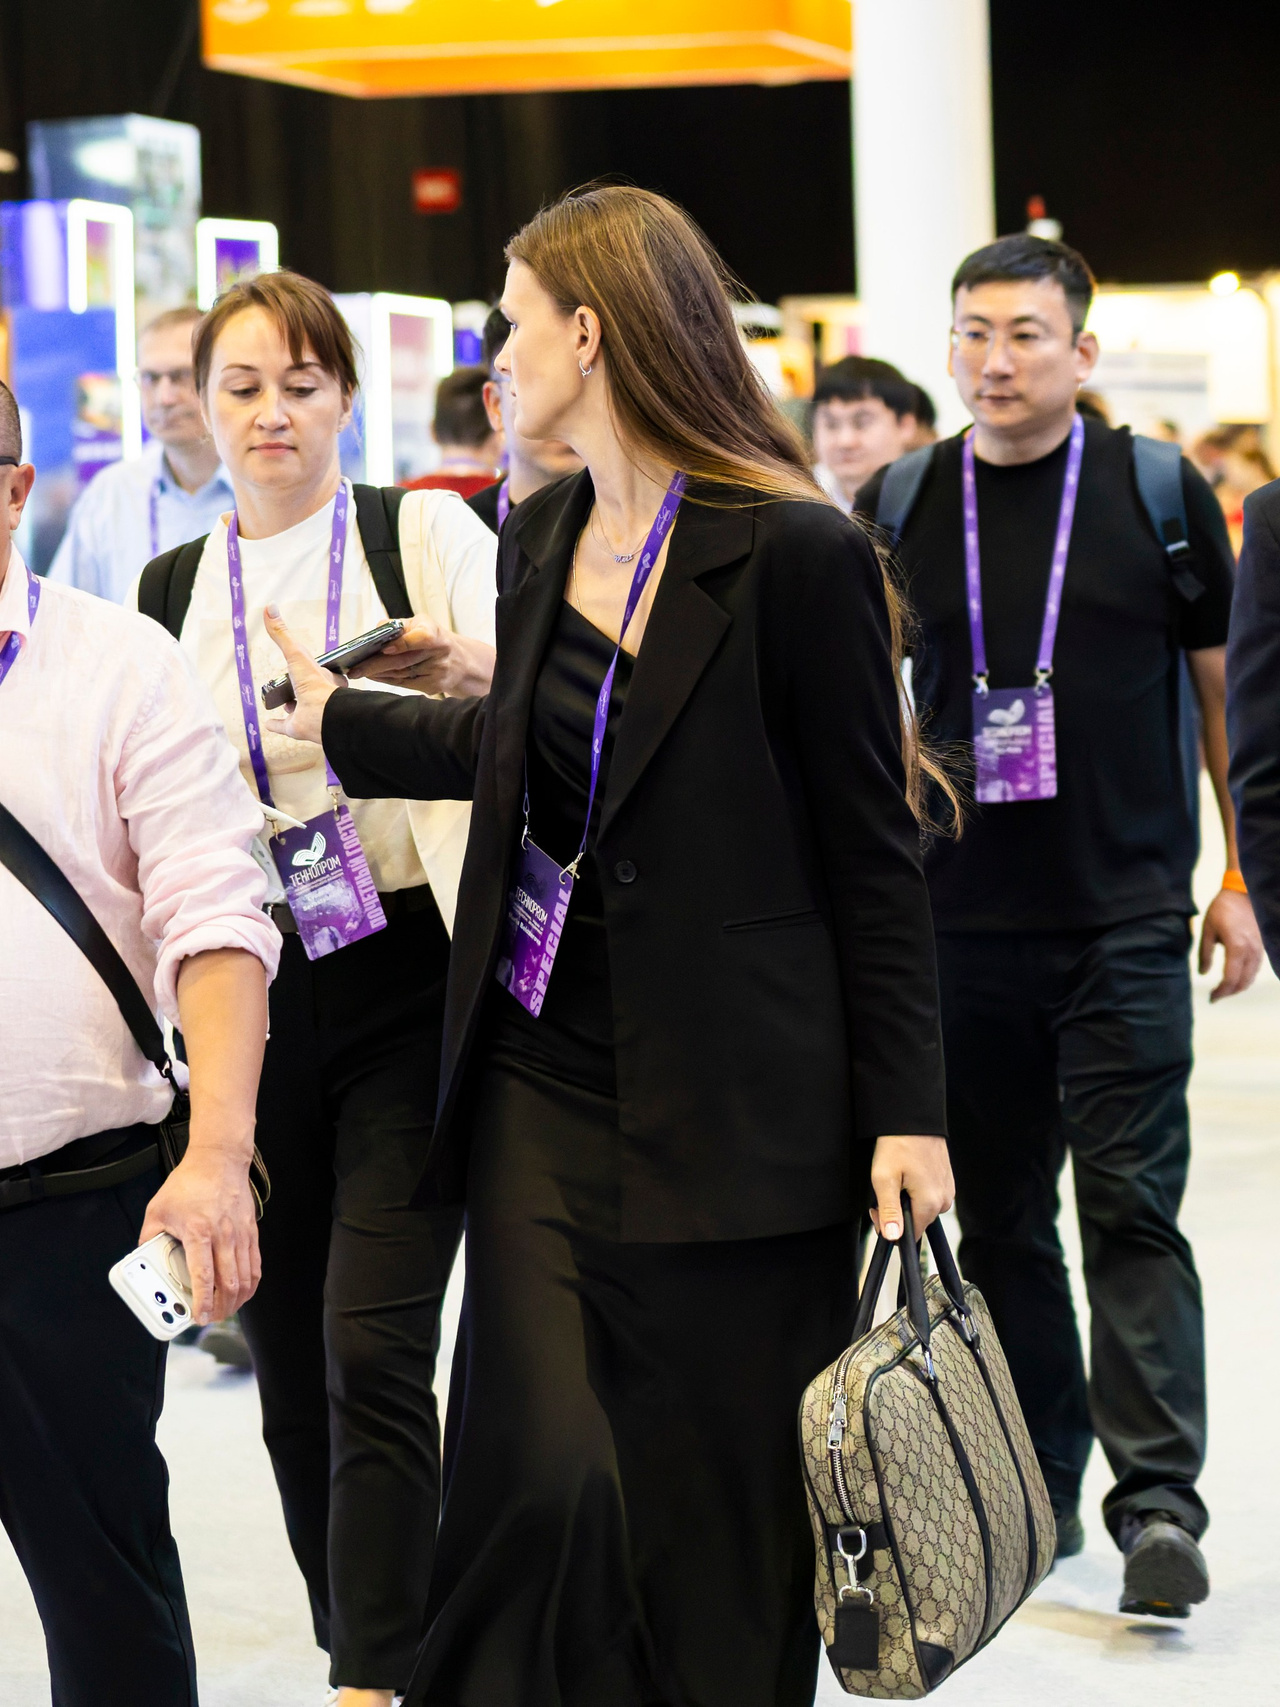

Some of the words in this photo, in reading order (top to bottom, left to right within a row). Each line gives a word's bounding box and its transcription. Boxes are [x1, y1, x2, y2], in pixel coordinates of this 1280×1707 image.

[347, 856, 388, 930] ПОЧЕТНЫЙ
[516, 886, 549, 926] TECHNOPROM
[529, 887, 572, 1016] SPECIAL
